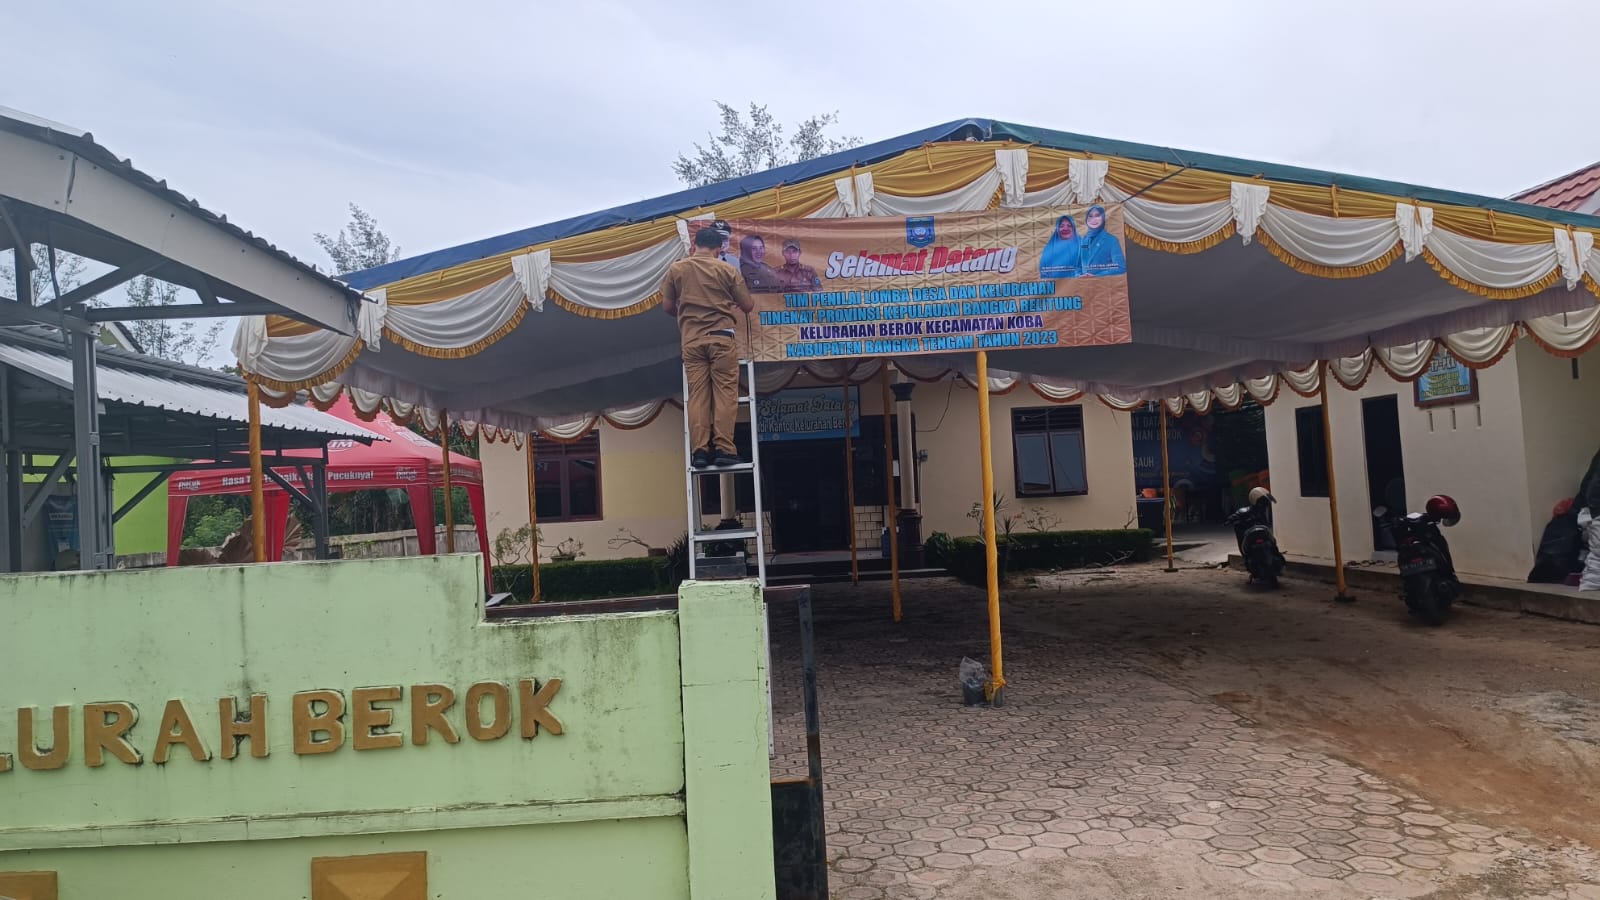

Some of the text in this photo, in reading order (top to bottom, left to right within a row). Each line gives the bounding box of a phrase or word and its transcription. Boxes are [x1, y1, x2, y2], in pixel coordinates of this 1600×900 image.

[825, 246, 1018, 280] Selamat Datang
[784, 280, 1056, 308] TIM PENILAI LOMBA DESA DAN KELURAHAN
[759, 296, 1083, 325] TINGKAT PROVINSI KEPULAUAN BANGKA BELITUNG
[800, 314, 1043, 340] KELURAHAN BEROK KECAMATAN KOBA
[786, 330, 1058, 358] KABUPATEN BANGKA TENGAH TAHUN 2023
[759, 399, 810, 417] Selamat
[328, 470, 374, 481] Pucuknya!
[0, 677, 564, 774] URAH BEROK
